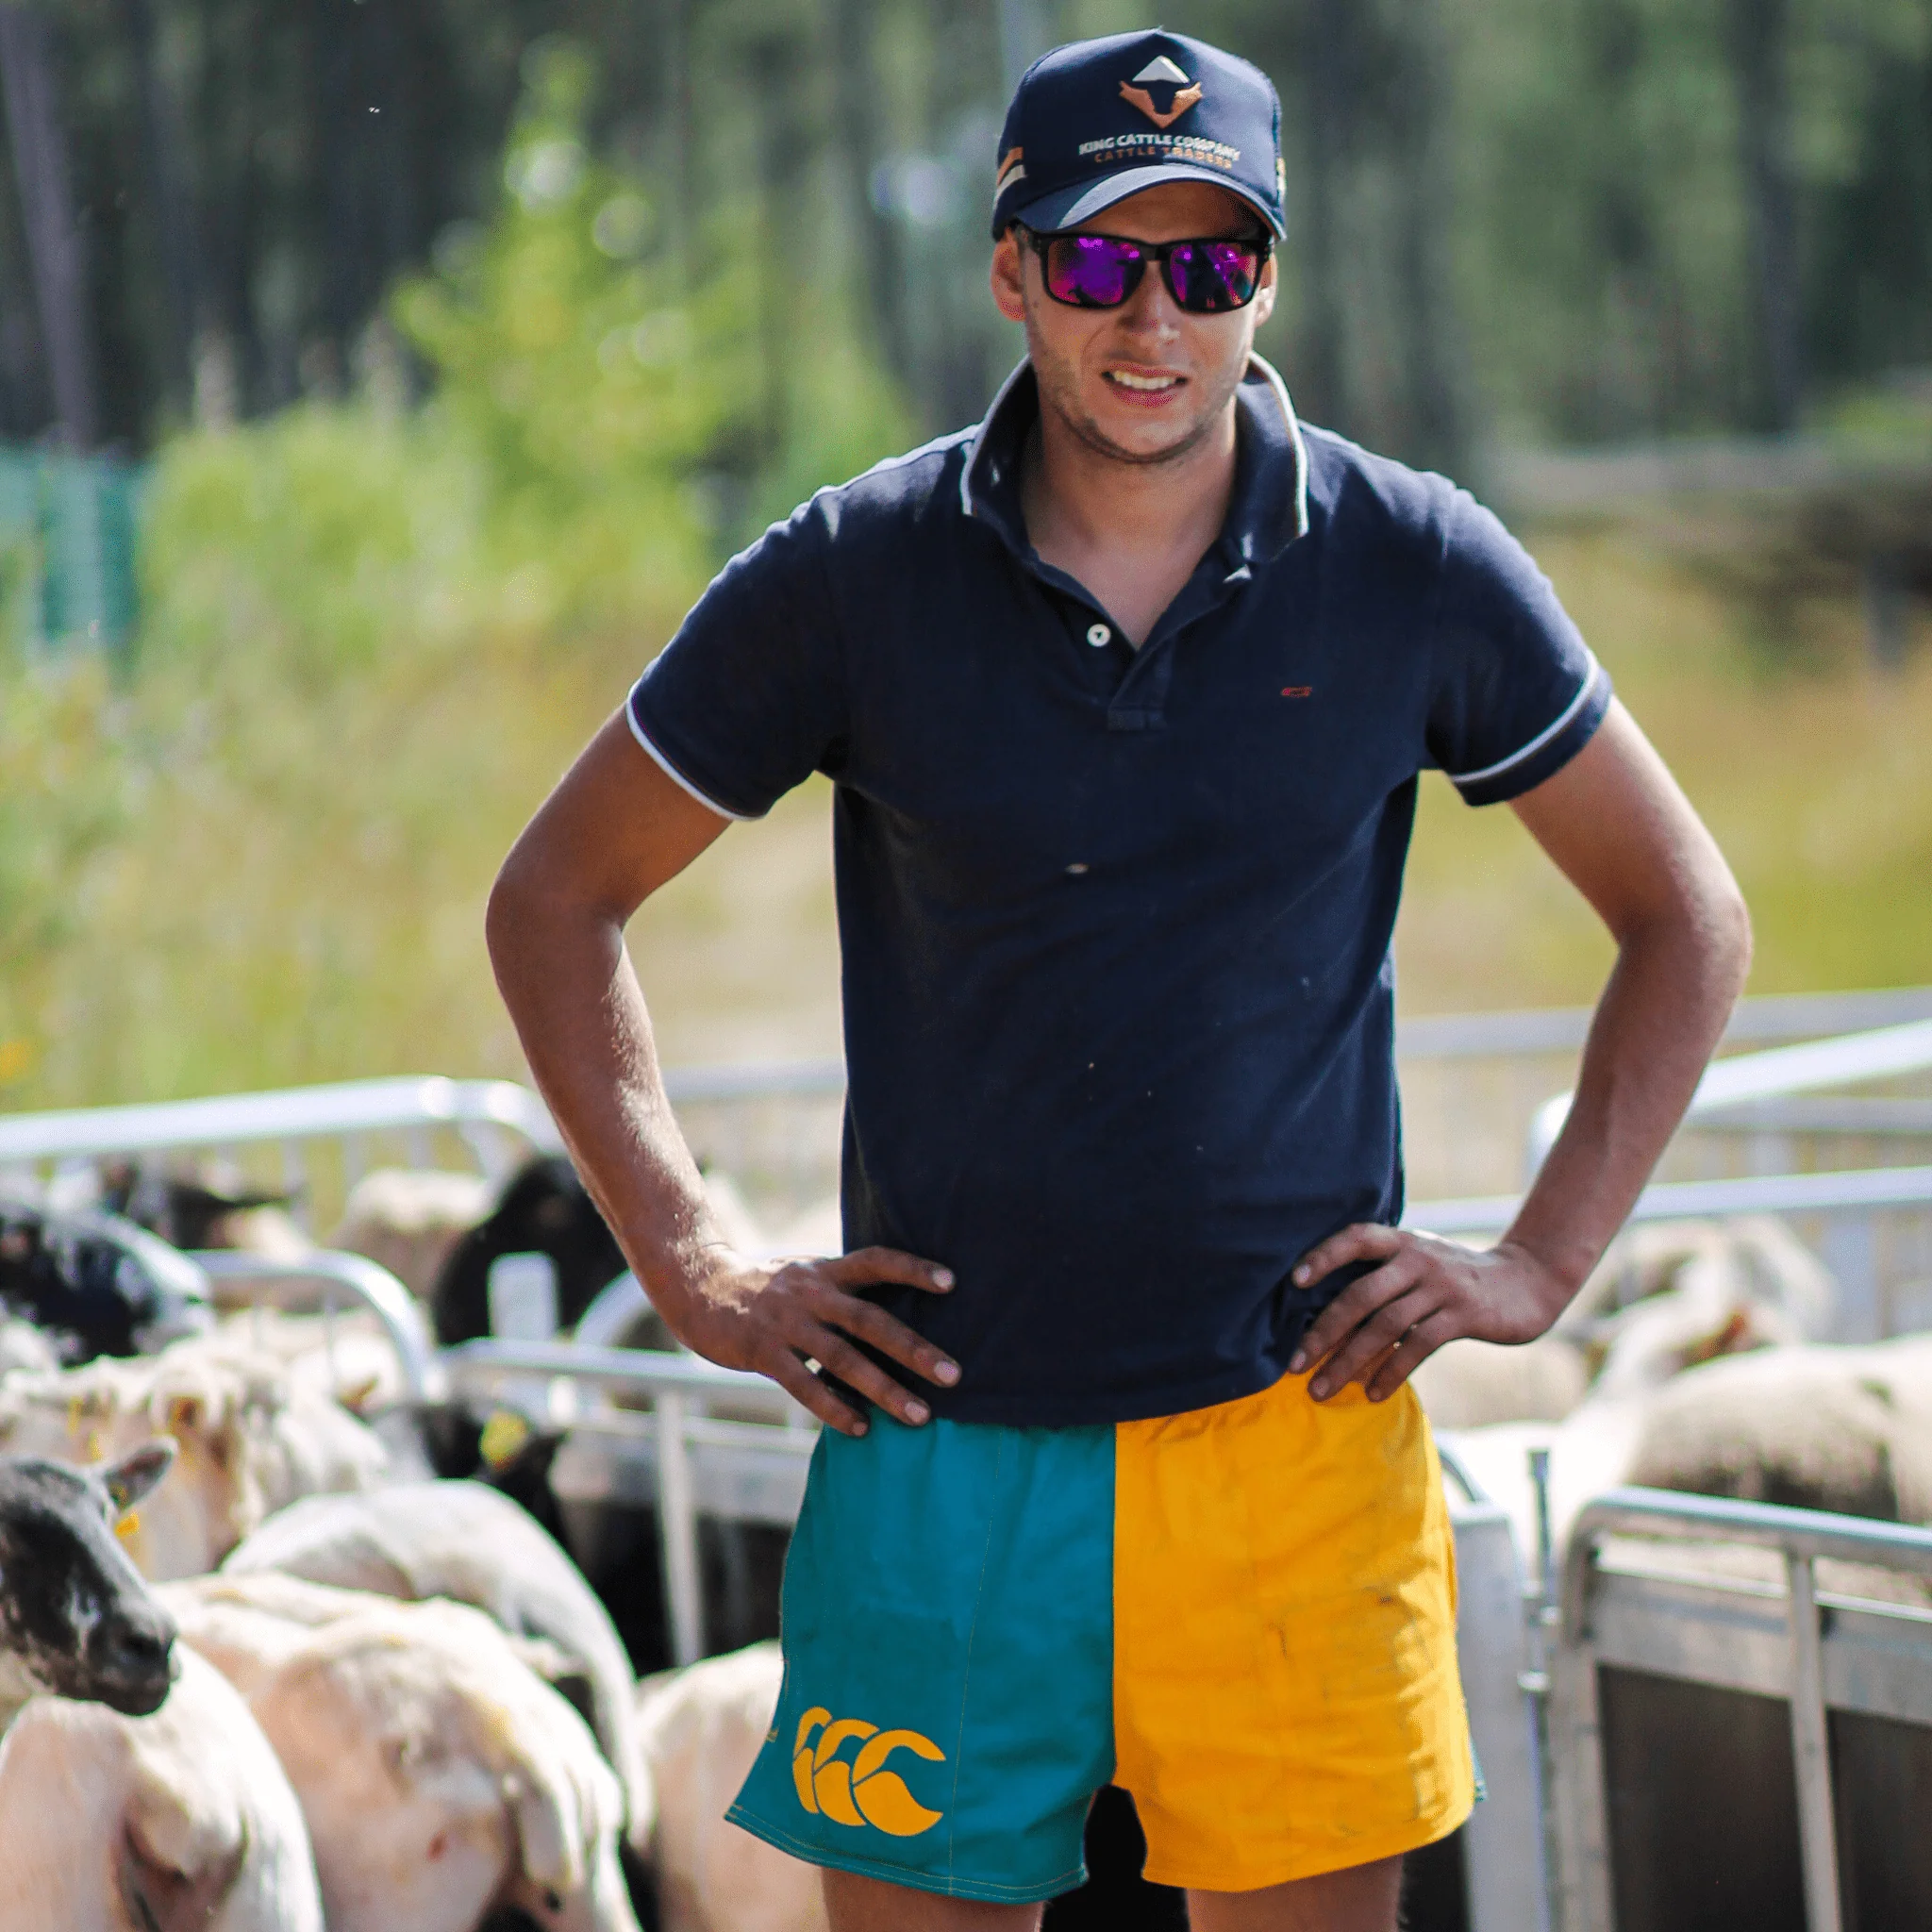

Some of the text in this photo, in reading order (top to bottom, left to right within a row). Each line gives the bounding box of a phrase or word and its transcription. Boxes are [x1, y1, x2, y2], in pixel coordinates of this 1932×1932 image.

[1078, 134, 1241, 161] KING CATTLE COMPANY
[1094, 146, 1157, 162] CATTLE
